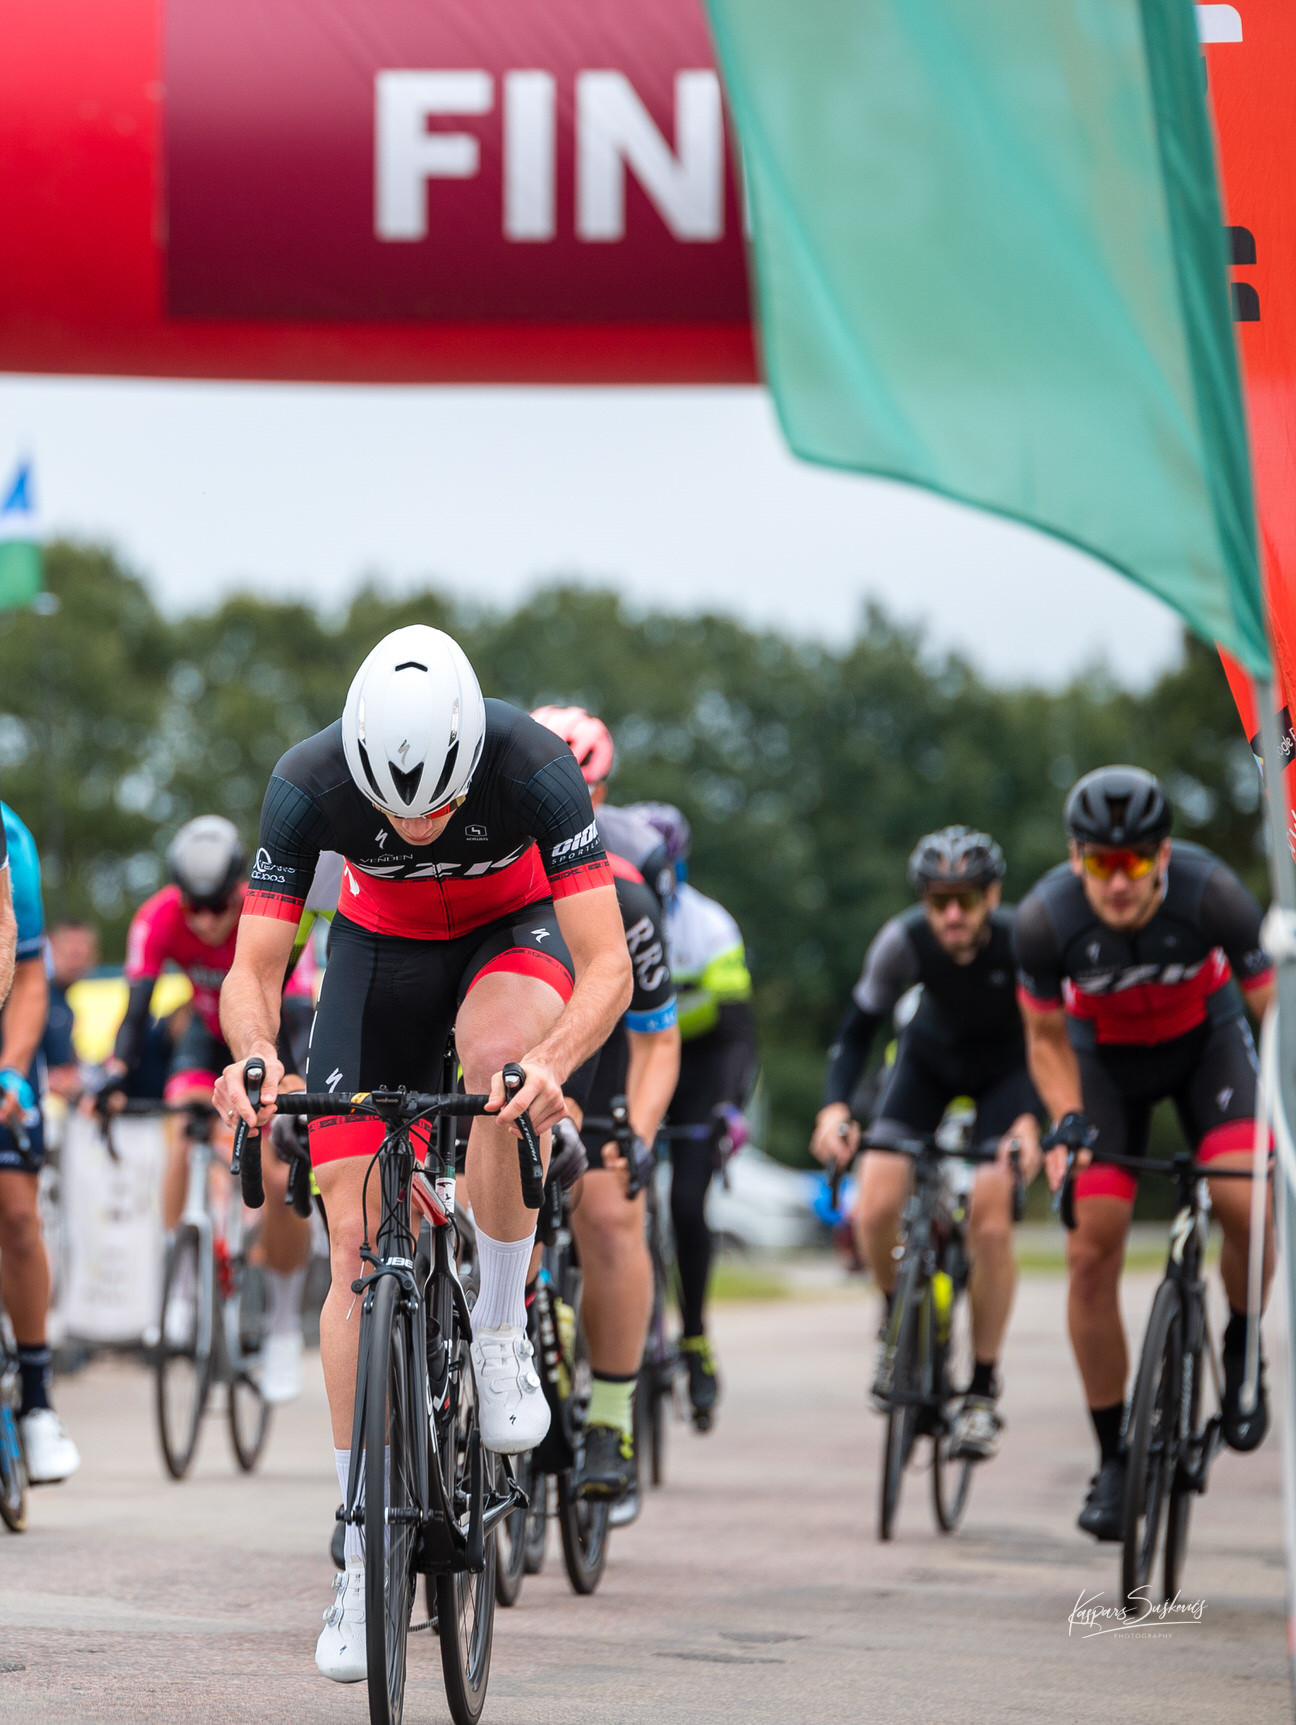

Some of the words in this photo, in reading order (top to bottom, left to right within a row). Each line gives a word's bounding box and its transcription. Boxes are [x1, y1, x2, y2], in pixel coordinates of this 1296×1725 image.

[373, 67, 752, 244] FIN
[551, 836, 601, 865] SPORTLA
[381, 1256, 413, 1270] UBE
